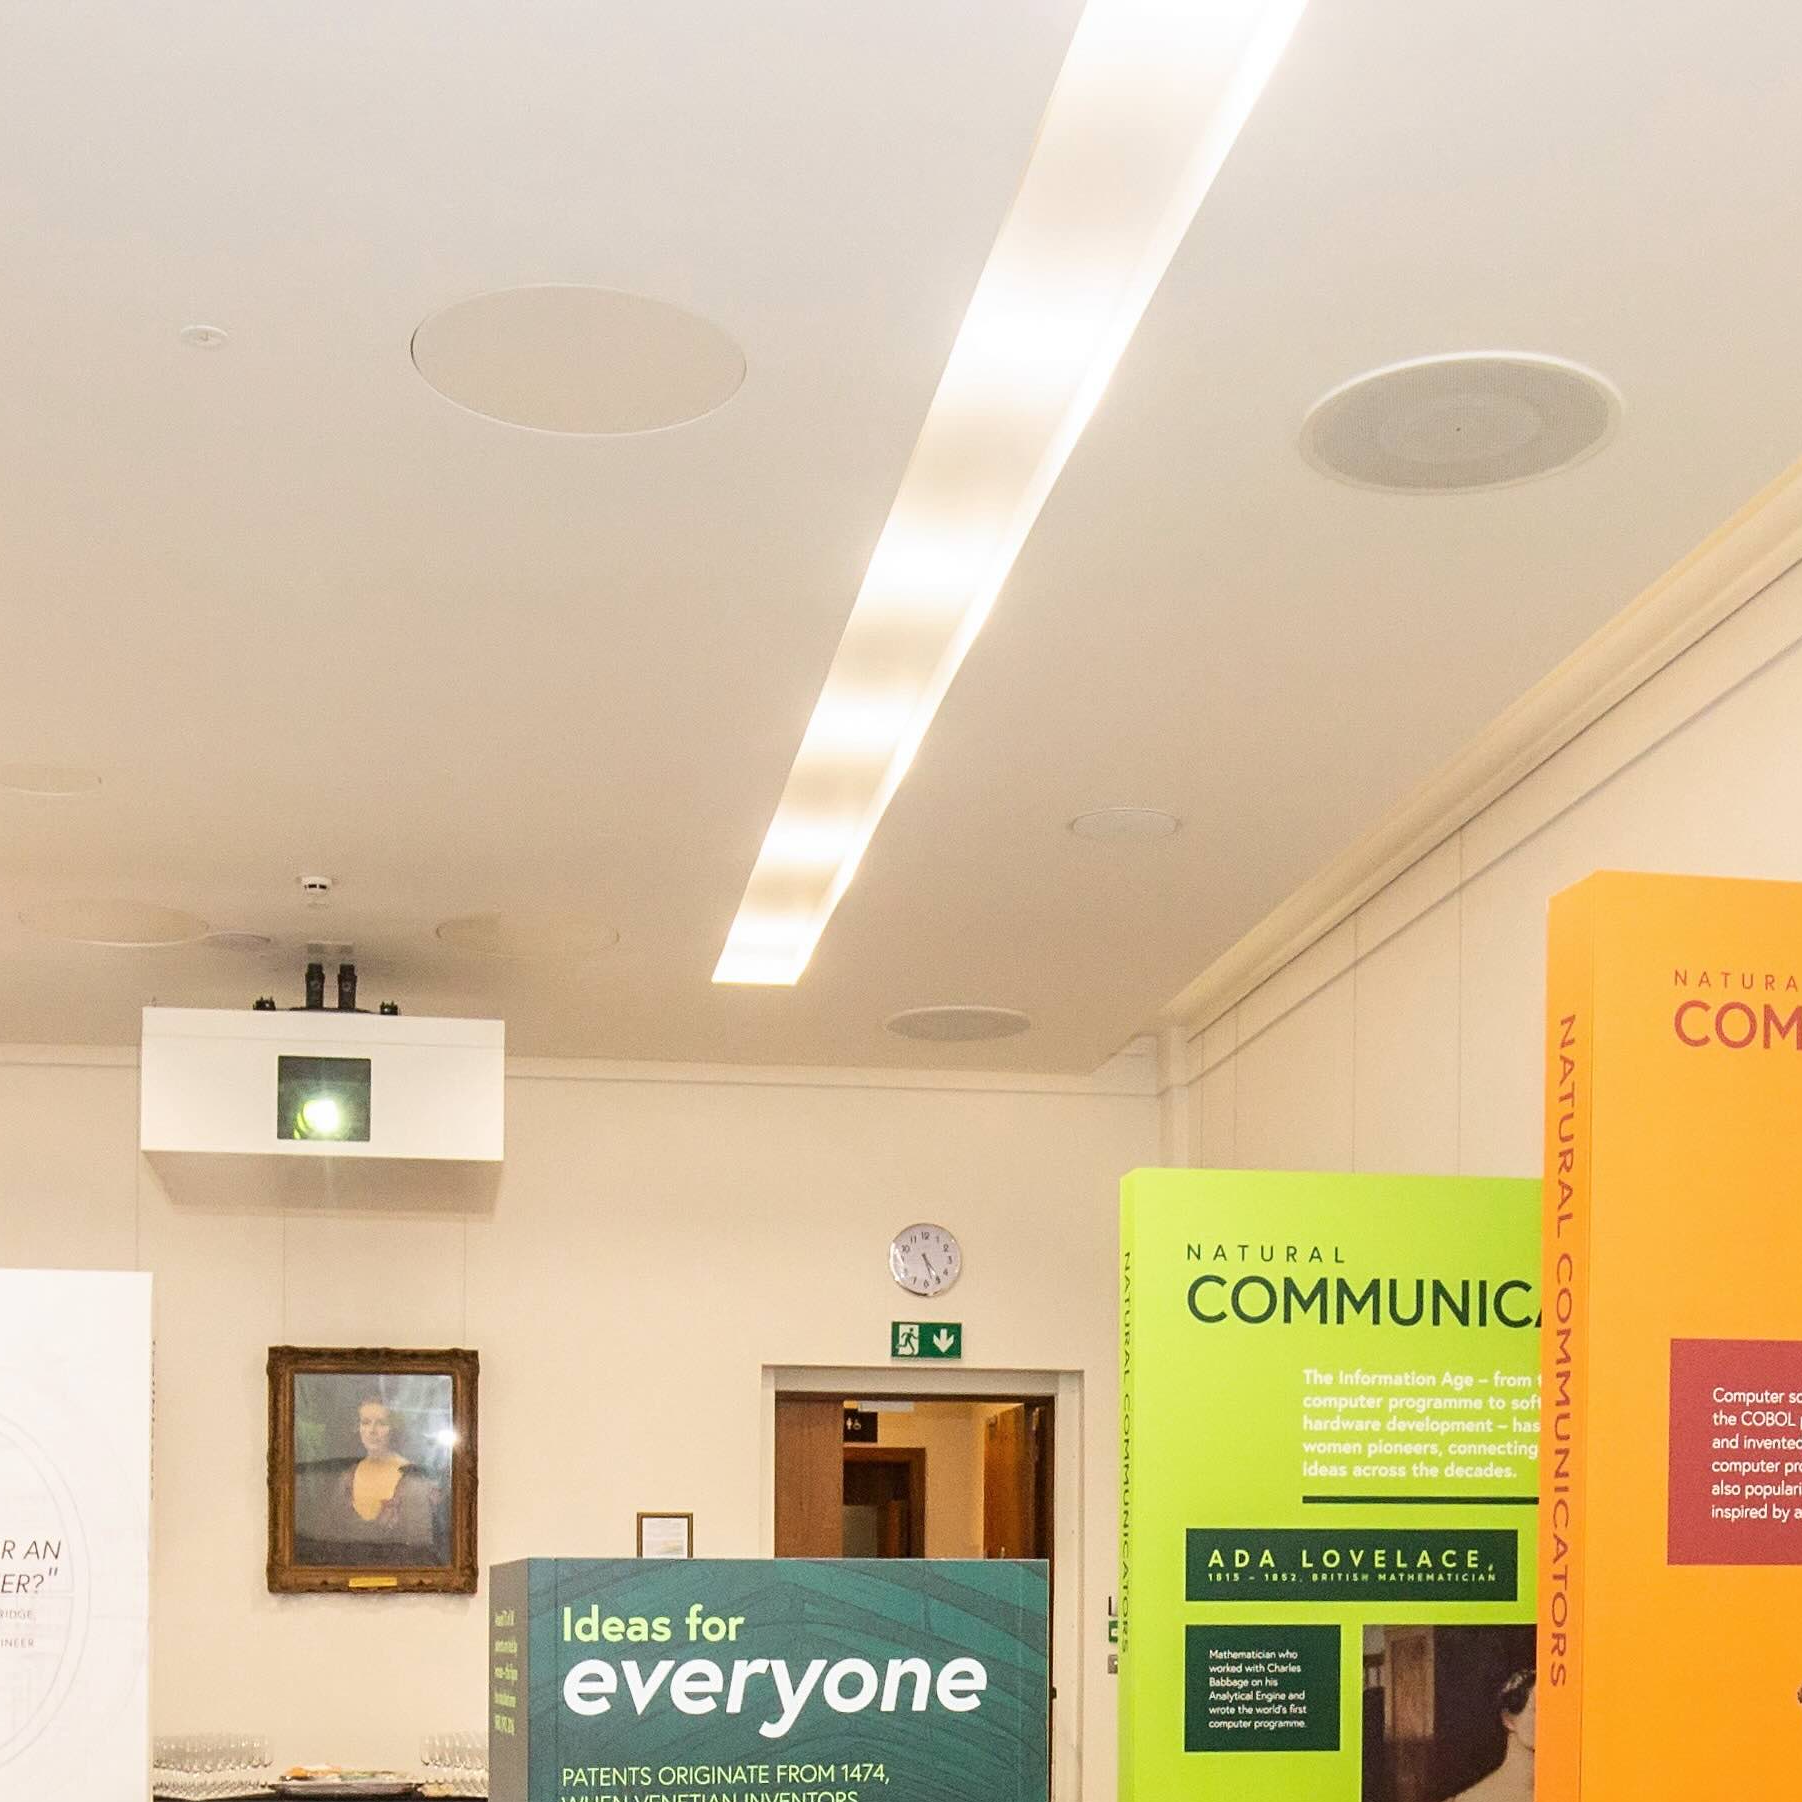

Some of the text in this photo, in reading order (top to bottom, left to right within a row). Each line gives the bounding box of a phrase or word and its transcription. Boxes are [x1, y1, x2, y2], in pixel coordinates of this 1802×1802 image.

[1187, 1243, 1345, 1264] NATURAL
[1187, 1275, 1542, 1329] COMMUNIC
[1549, 1014, 1578, 1688] NATURAL COMMUNICATORS
[1303, 1368, 1334, 1385] The
[1338, 1368, 1436, 1386] Information
[1441, 1371, 1474, 1391] Age
[1493, 1371, 1532, 1387] from
[1712, 1387, 1785, 1407] Computer
[1712, 1409, 1737, 1426] the
[1740, 1410, 1797, 1427] COBOL
[1120, 1251, 1132, 1655] NATURAL COMMUNICATORS
[1302, 1439, 1538, 1460] women pioneers, connecting
[1303, 1460, 1517, 1478] ideas across the decades.
[1711, 1503, 1768, 1523] inspired
[1772, 1503, 1791, 1523] by
[1793, 1508, 1802, 1520] a
[23, 1540, 62, 1560] AN
[1208, 1549, 1493, 1571] ADA LOVELACE,
[563, 1604, 745, 1643] Ideas for
[1209, 1649, 1299, 1660] Mathematician who
[1209, 1662, 1302, 1673] worked with Charles
[563, 1657, 988, 1738] everyone
[1208, 1703, 1307, 1715] wrote the world's first
[562, 1763, 890, 1787] PATENTS ORIGINATE FROM 1474,
